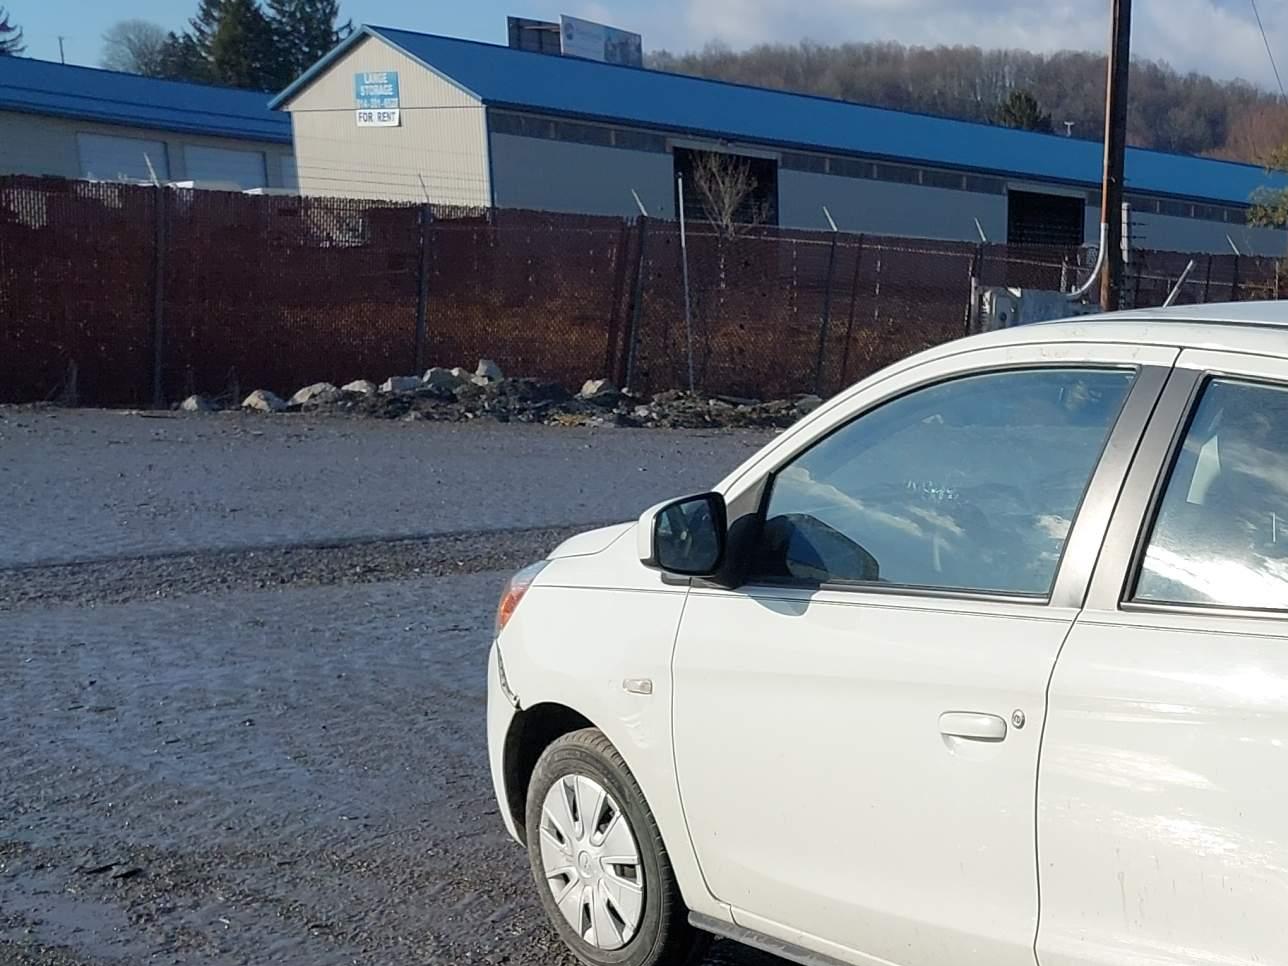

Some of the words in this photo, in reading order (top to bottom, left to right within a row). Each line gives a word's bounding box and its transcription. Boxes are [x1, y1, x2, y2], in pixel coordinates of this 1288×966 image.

[360, 84, 393, 96] STORAGE
[358, 111, 373, 123] FOR
[377, 111, 396, 122] RENT
